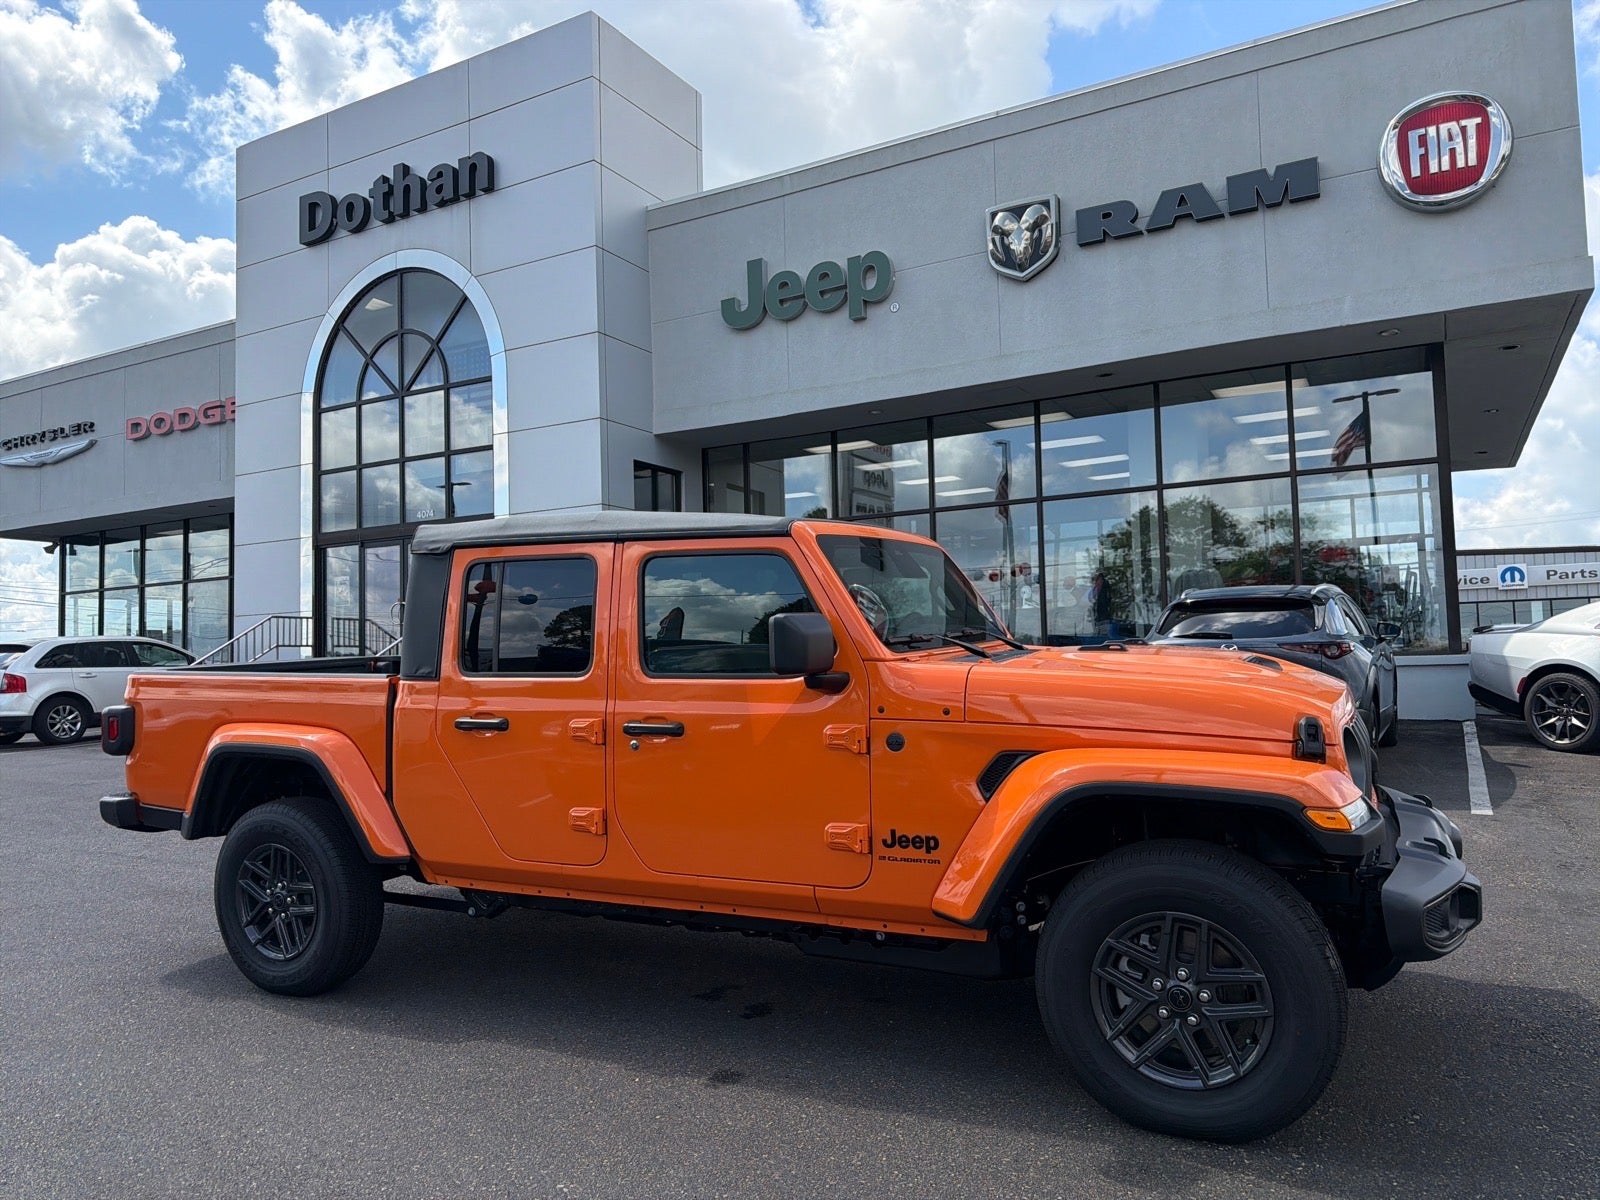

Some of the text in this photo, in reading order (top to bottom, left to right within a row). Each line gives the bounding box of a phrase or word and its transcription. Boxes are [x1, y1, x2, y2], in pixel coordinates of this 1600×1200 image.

[1408, 117, 1482, 178] FIAT
[299, 151, 495, 247] Dothan
[1075, 156, 1321, 247] RAM
[720, 250, 896, 331] Jeep
[0, 421, 96, 451] CHRYSLER
[1546, 569, 1598, 581] Parts
[881, 828, 940, 855] Jeep
[887, 855, 941, 865] GLADIATOR
